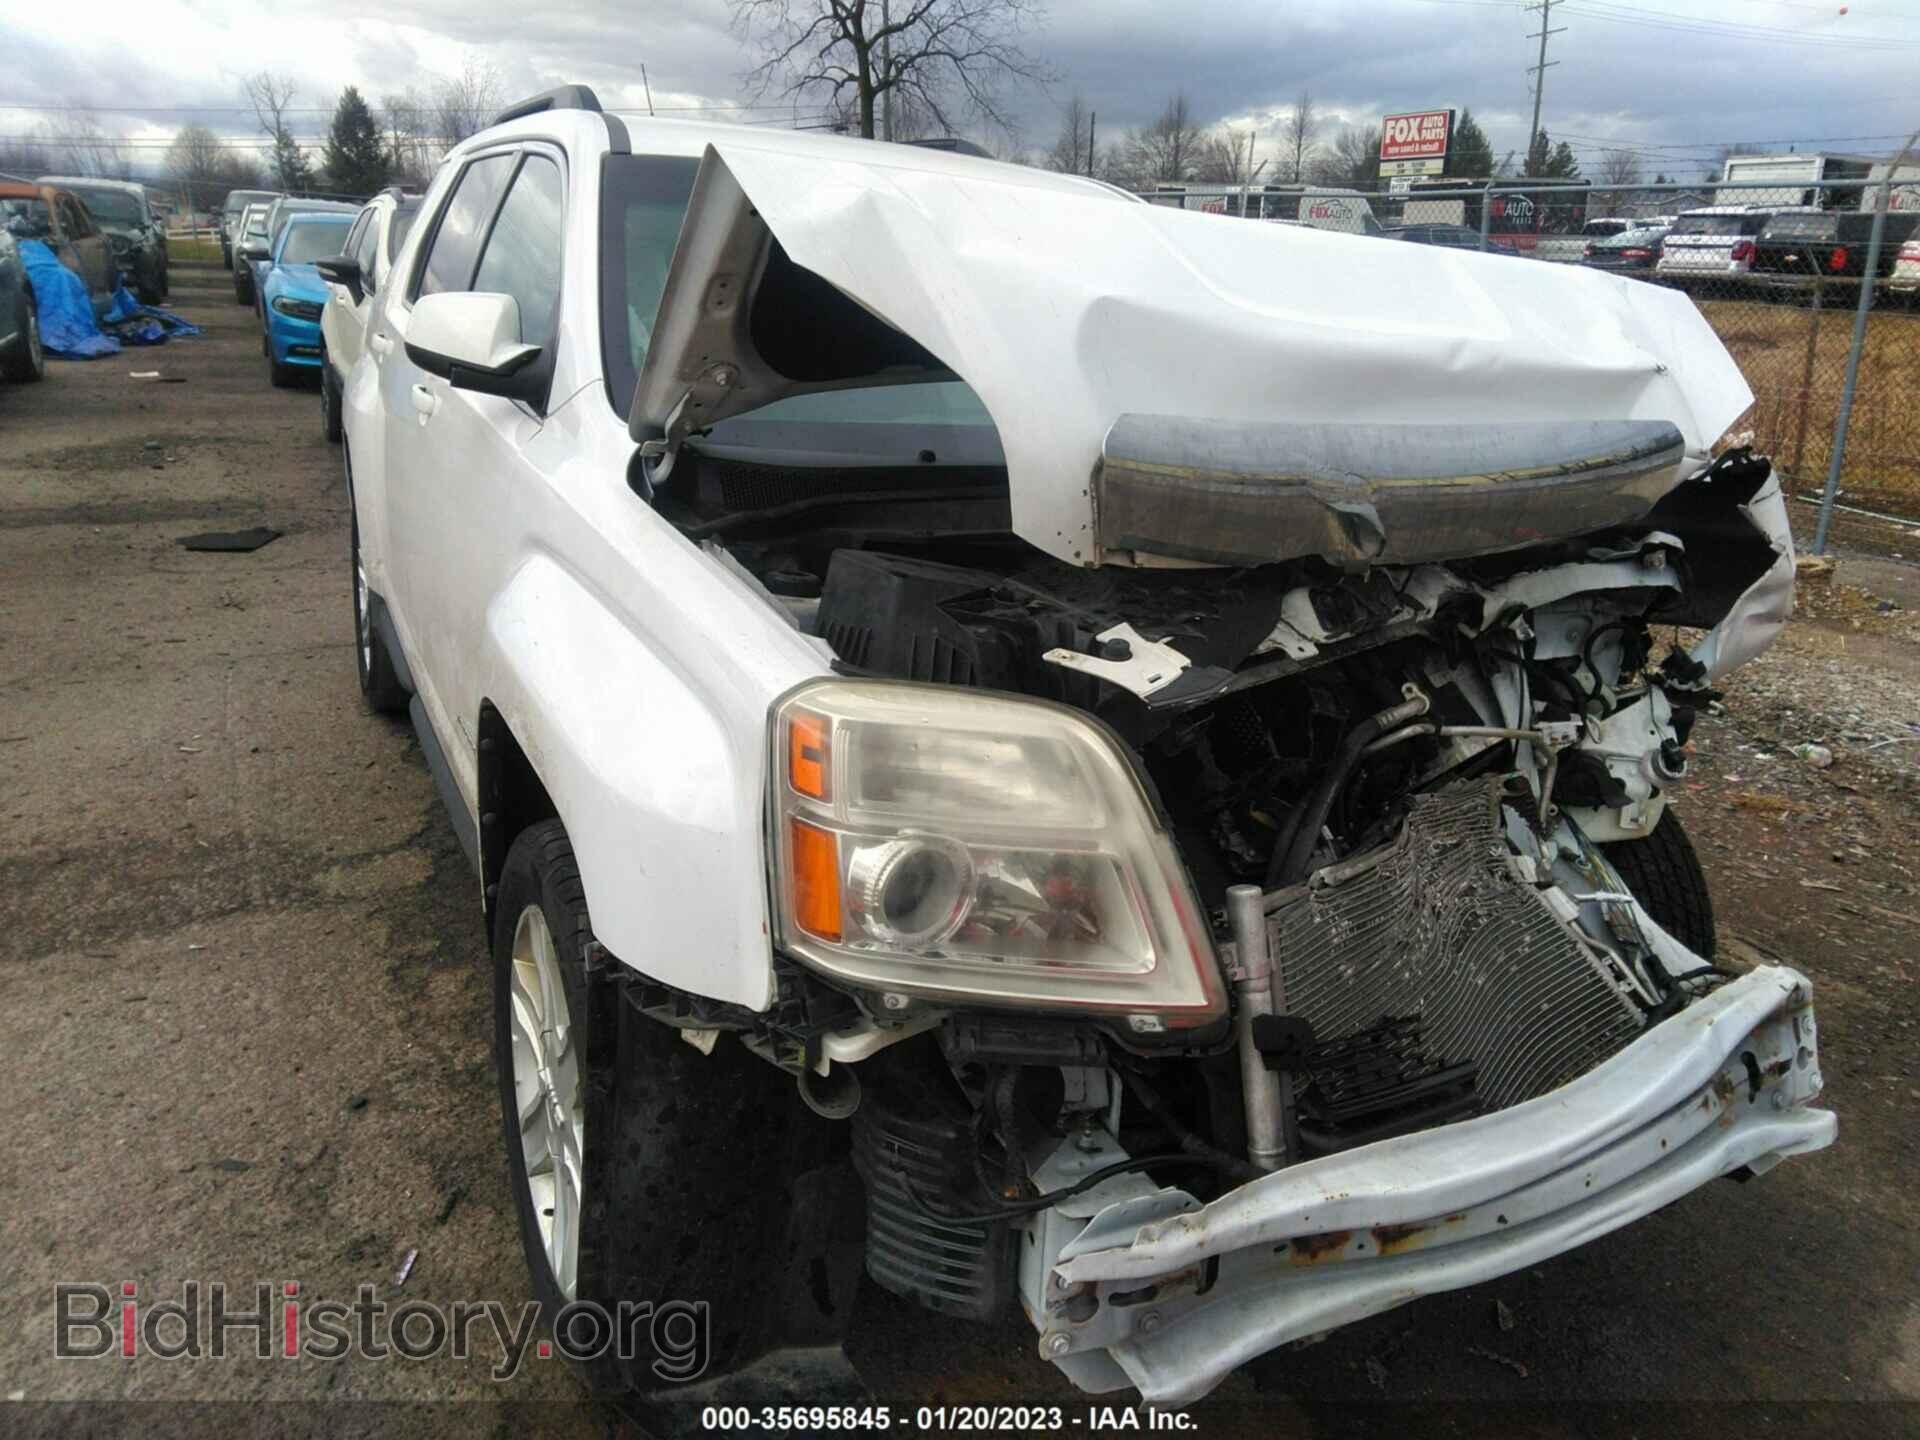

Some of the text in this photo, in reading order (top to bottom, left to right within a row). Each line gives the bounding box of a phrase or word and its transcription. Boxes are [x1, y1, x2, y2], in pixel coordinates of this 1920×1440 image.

[1423, 115, 1444, 128] AUTO
[1385, 117, 1421, 143] FOX
[1421, 128, 1444, 140] PARTS
